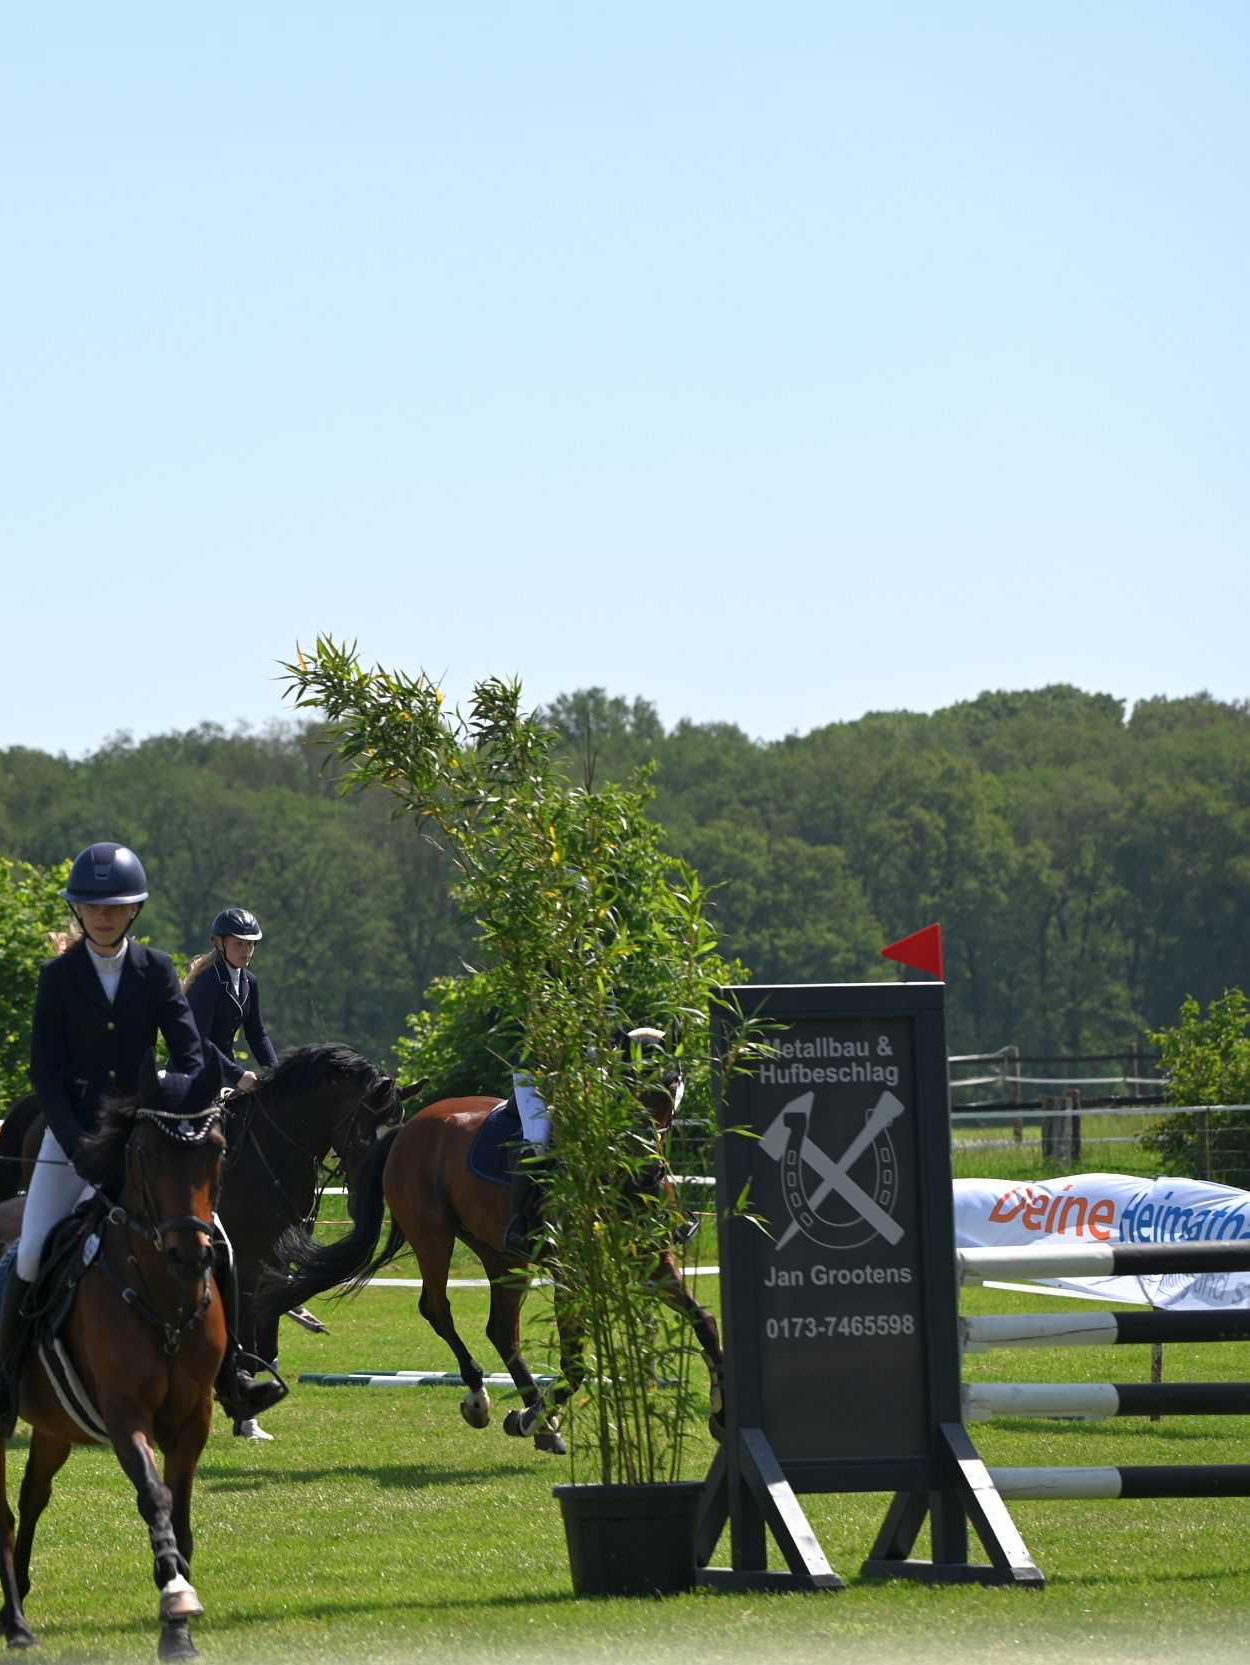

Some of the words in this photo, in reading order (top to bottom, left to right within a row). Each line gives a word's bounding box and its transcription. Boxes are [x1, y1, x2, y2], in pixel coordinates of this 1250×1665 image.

[762, 1037, 869, 1058] Metallbau
[876, 1035, 893, 1056] &
[760, 1062, 899, 1086] Hufbeschlag
[988, 1184, 1116, 1241] Deine
[1119, 1191, 1250, 1243] Heimath
[764, 1267, 803, 1287] Jan
[810, 1264, 913, 1287] Grootens
[766, 1314, 914, 1339] 0173-7465598
